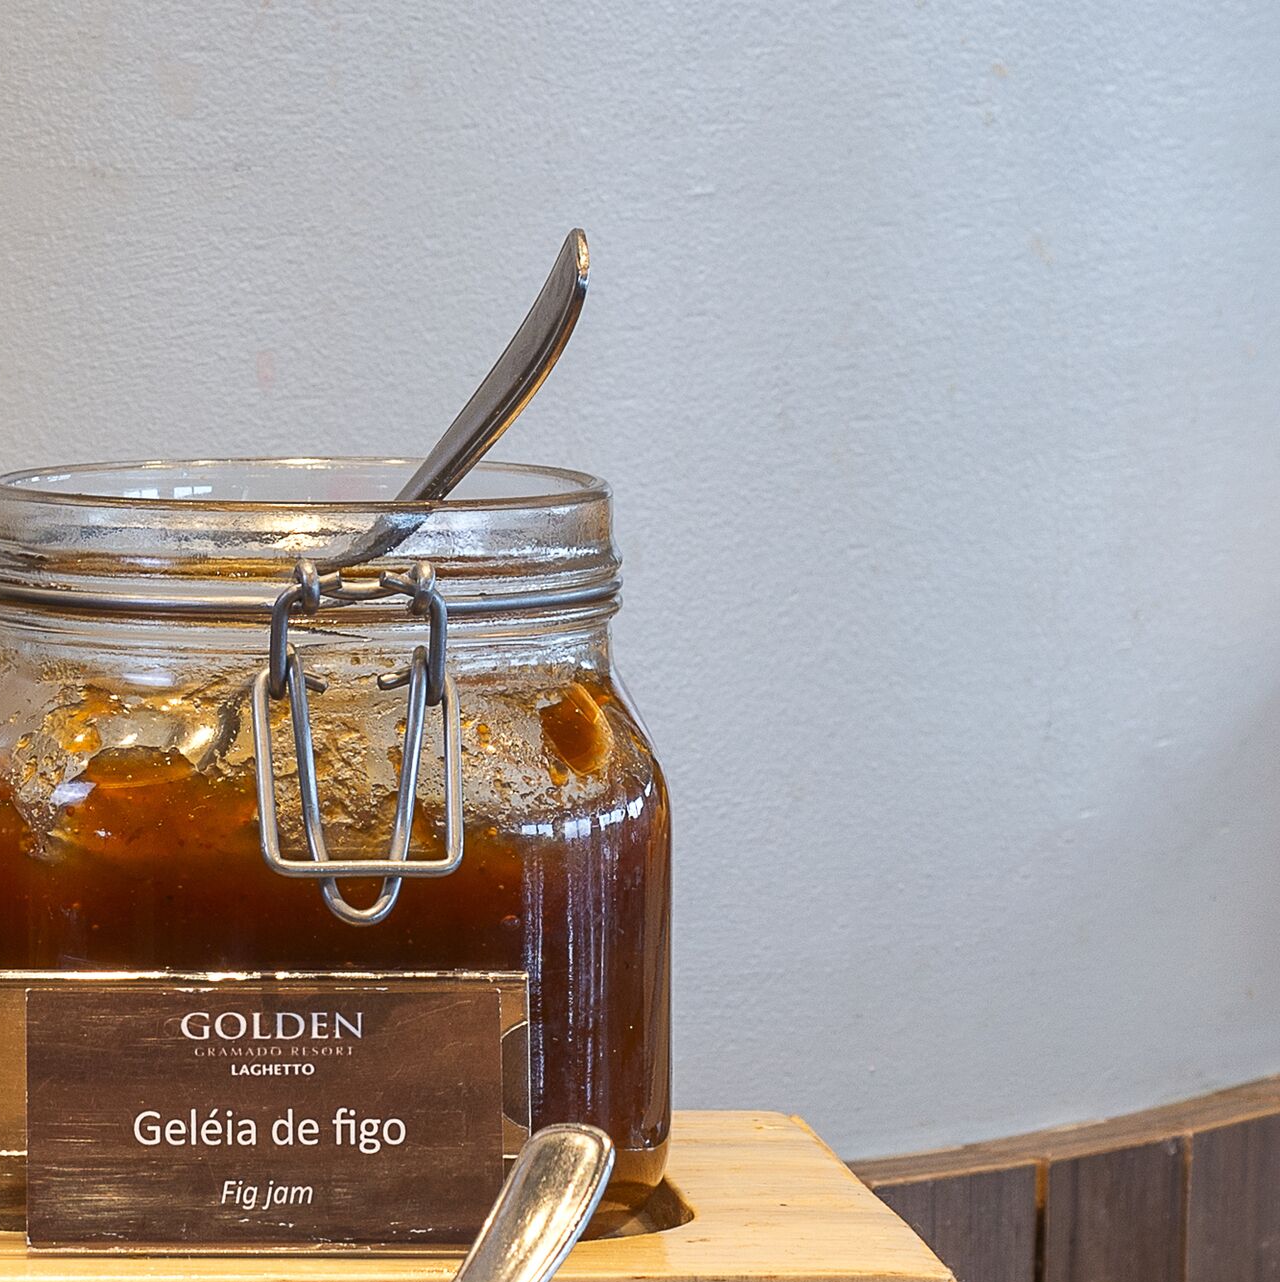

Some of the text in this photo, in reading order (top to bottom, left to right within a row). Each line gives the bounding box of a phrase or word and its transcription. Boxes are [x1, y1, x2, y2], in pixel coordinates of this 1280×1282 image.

[180, 1011, 364, 1041] GOLDEN
[193, 1046, 354, 1057] GRAMADO RESORT
[231, 1063, 315, 1077] LAGHETTO
[133, 1107, 407, 1155] Geléia de figo
[220, 1180, 313, 1211] Fig jam
